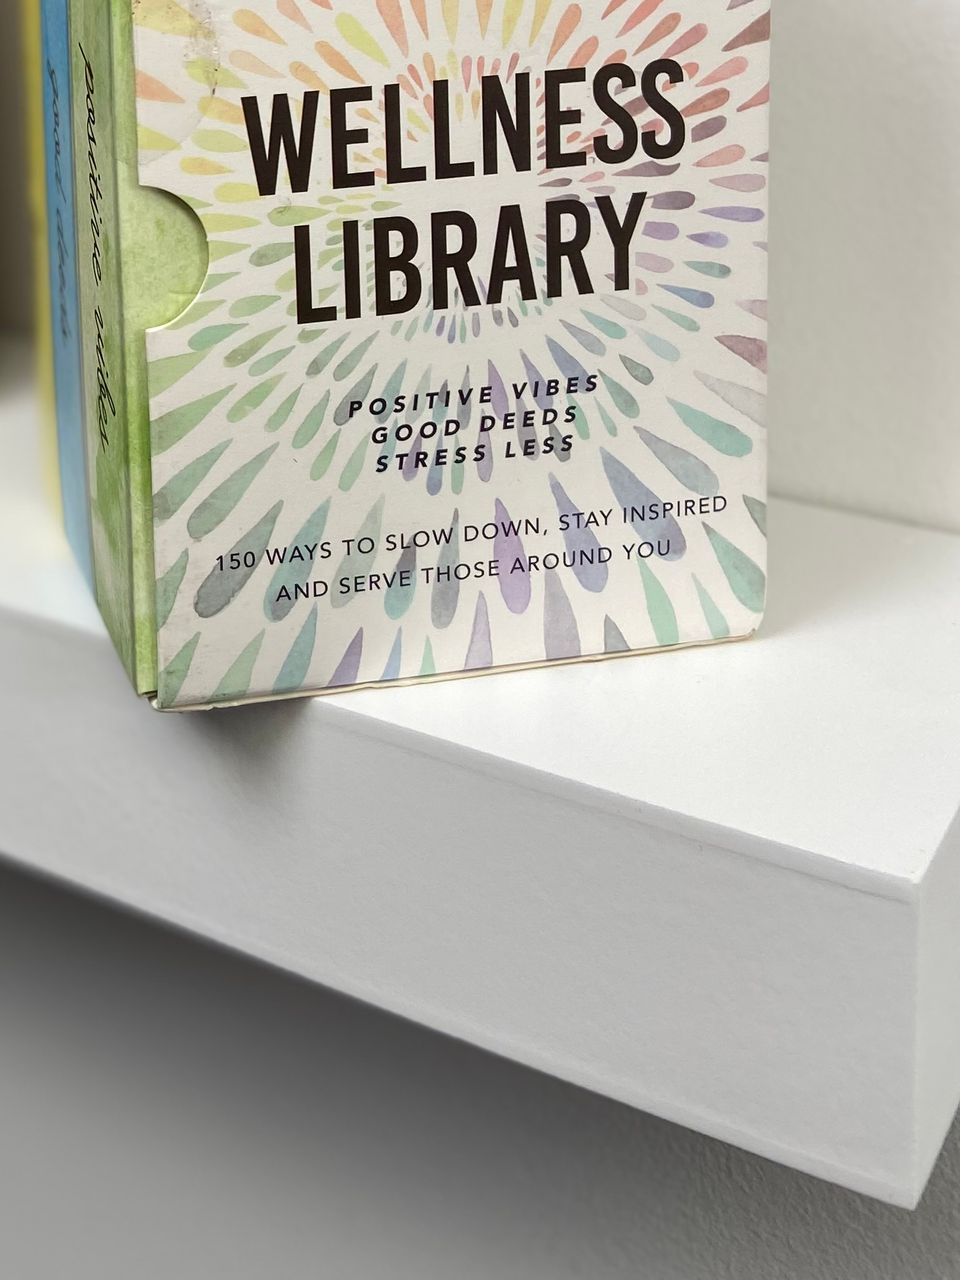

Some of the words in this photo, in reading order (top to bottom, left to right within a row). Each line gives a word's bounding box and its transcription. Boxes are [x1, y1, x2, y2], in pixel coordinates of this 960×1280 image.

[241, 58, 686, 197] WELLNESS
[79, 42, 103, 287] positive
[94, 306, 116, 453] vibes
[294, 191, 648, 325] LIBRARY
[348, 385, 494, 418] POSITIVE
[512, 374, 600, 401] VIBES
[371, 419, 461, 445] GOOD
[479, 405, 579, 433] DEEDS
[374, 444, 488, 474] STRESS
[504, 434, 575, 460] LESS
[214, 550, 257, 572] 150
[266, 541, 332, 567] WAYS
[342, 536, 375, 557] TO
[385, 526, 454, 552] SLOW
[463, 516, 548, 543] DOWN,
[558, 508, 612, 532] STAY
[622, 494, 728, 524] INSPIRED
[275, 579, 329, 603] AND
[338, 569, 412, 595] SERVE
[420, 558, 500, 585] THOSE
[509, 546, 613, 574] AROUND
[622, 539, 671, 560] YOU
